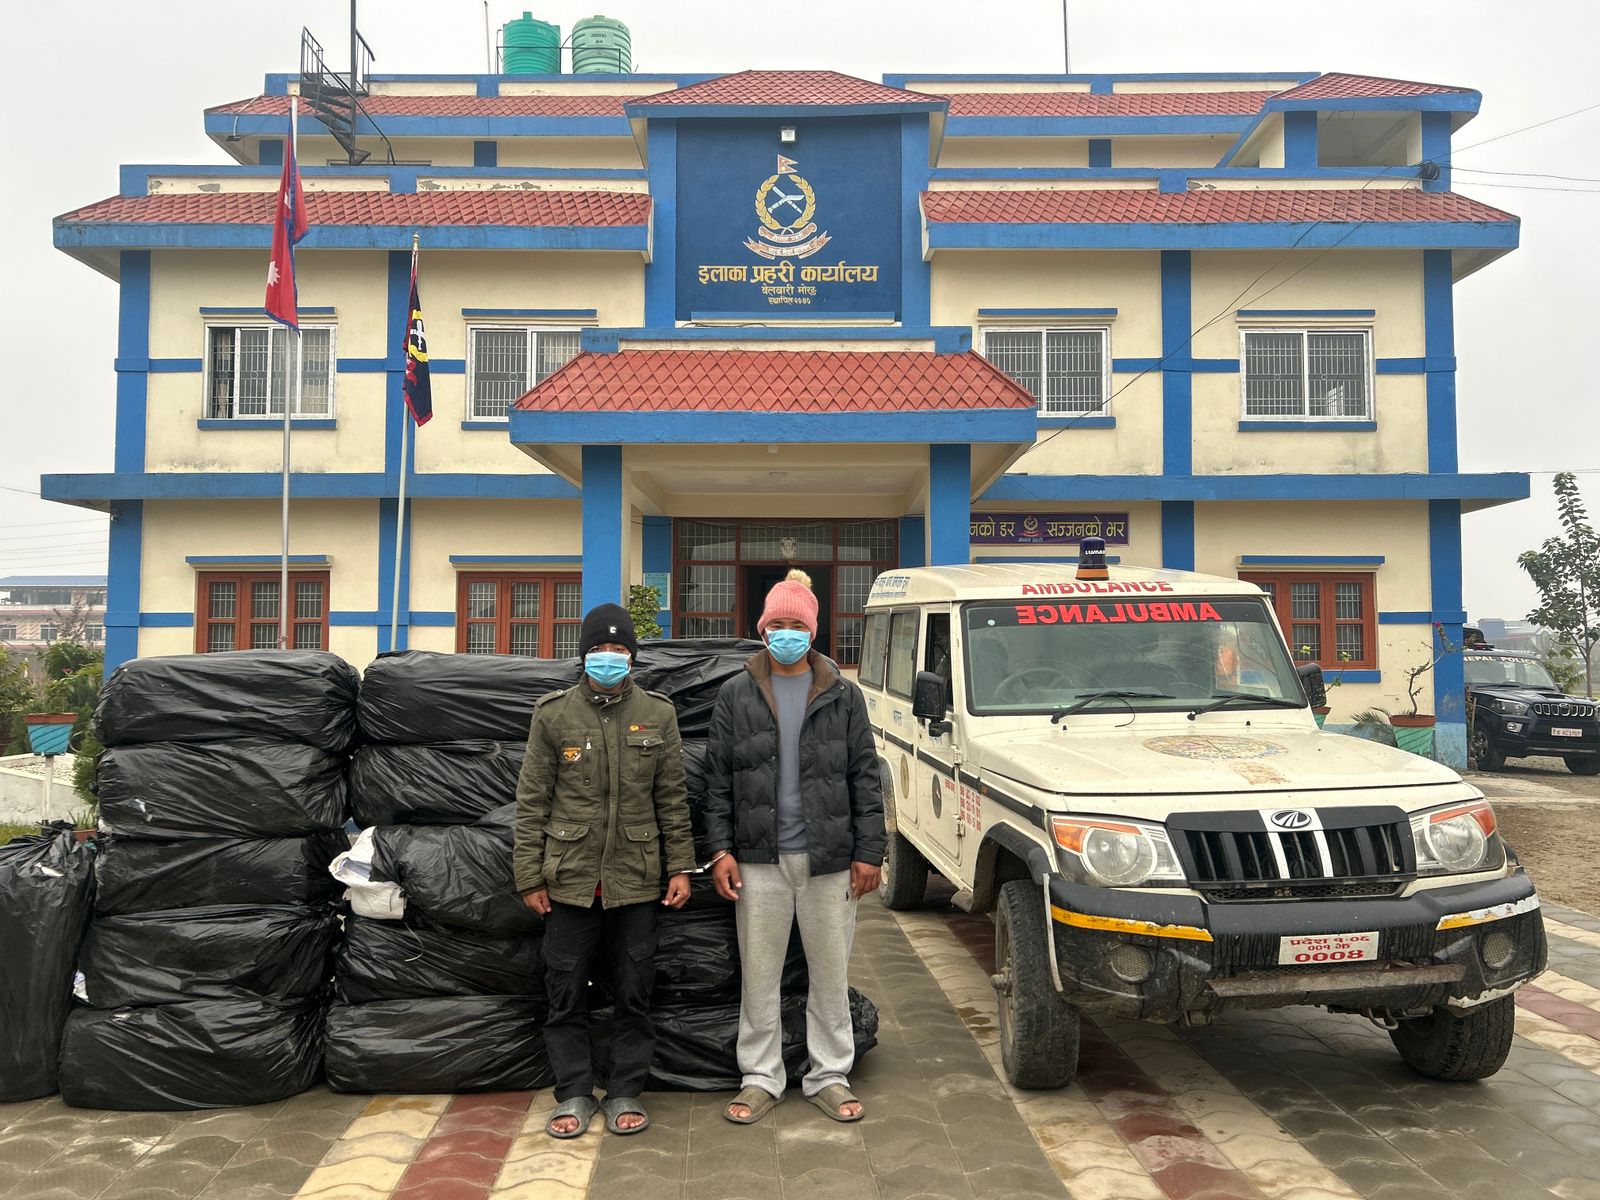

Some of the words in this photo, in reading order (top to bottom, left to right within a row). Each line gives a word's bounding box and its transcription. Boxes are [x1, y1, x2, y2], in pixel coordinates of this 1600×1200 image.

[698, 265, 748, 285] इलाका
[751, 260, 795, 284] प्रहरी
[800, 260, 879, 283] कार्यालय
[999, 521, 1015, 537] डर
[1046, 516, 1103, 538] सज्जनको
[1105, 521, 1125, 537] भर
[1022, 581, 1174, 595] AMBULANCE
[1500, 656, 1538, 665] POLICE
[1290, 938, 1329, 946] प्रदेश
